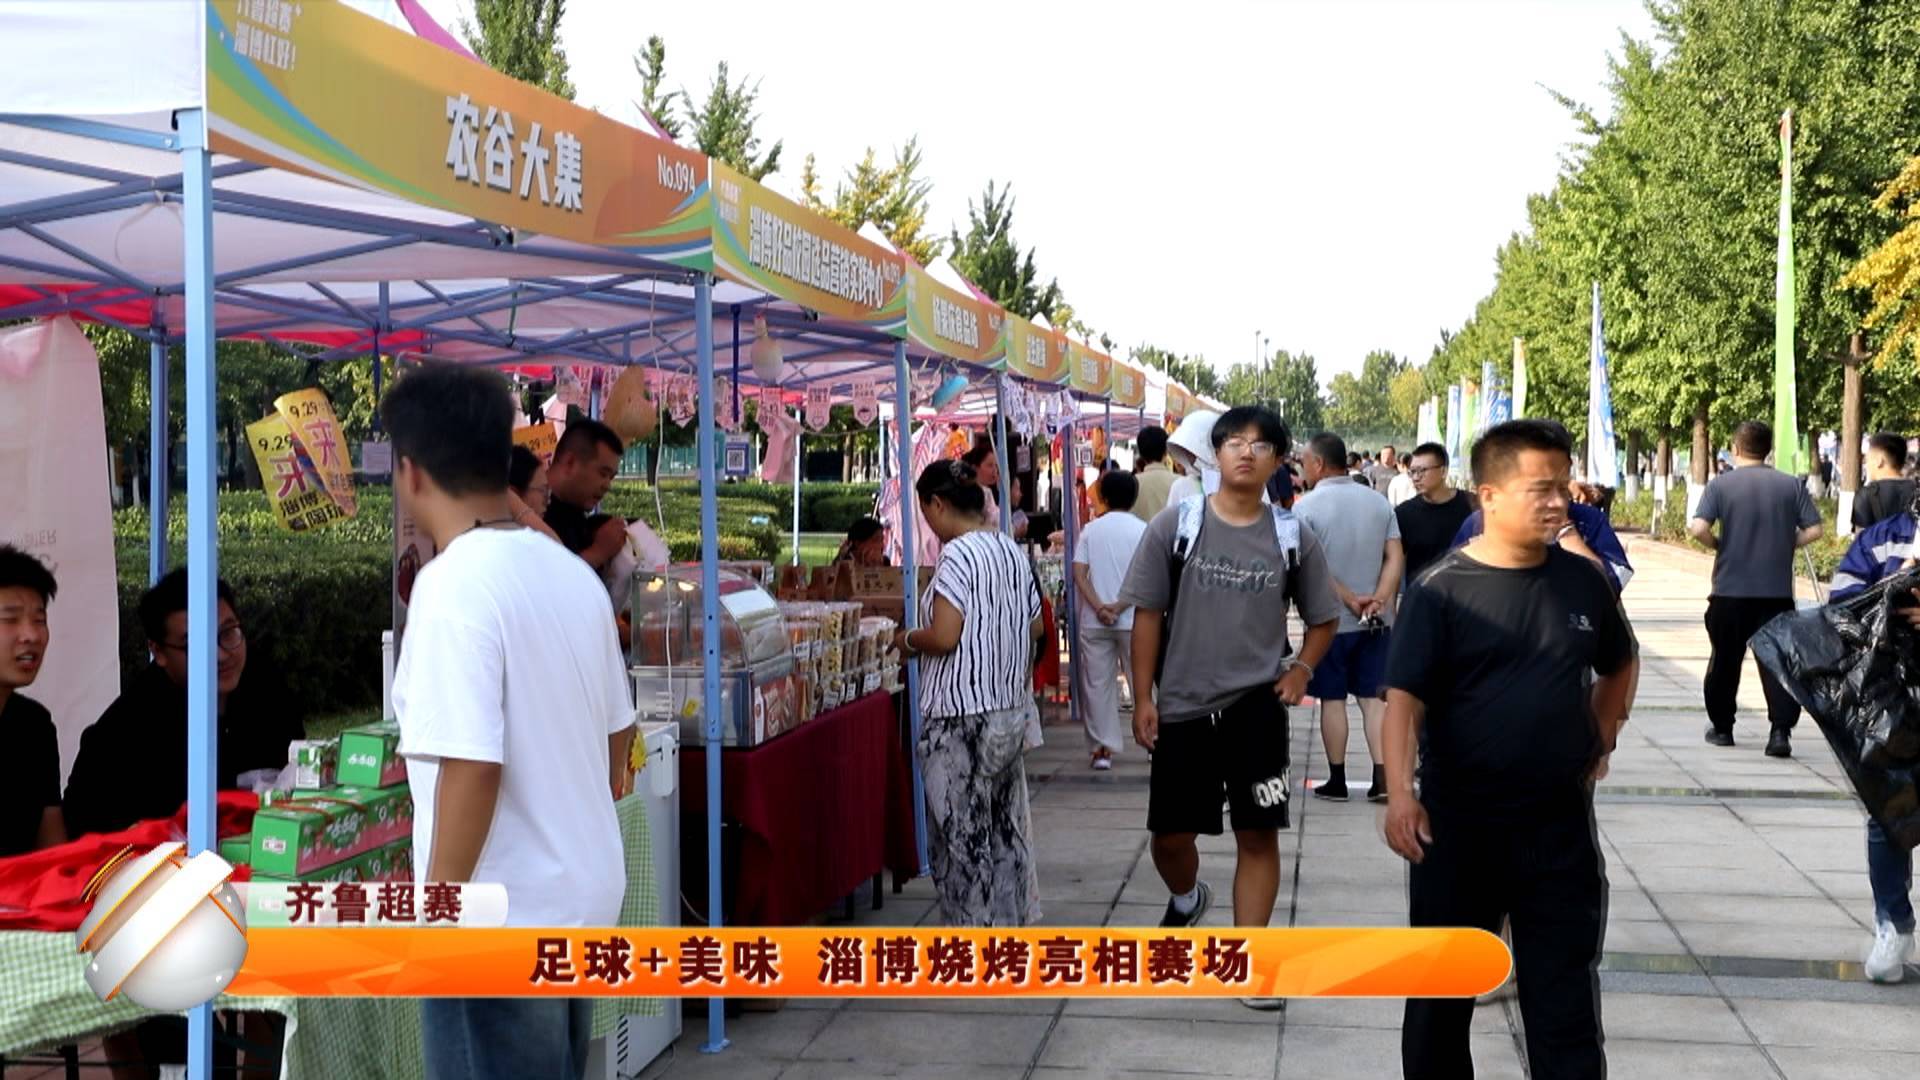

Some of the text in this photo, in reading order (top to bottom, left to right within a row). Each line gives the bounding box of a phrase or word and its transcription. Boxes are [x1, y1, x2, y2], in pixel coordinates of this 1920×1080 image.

[445, 93, 583, 212] 农谷大集
[658, 154, 695, 193] No.094
